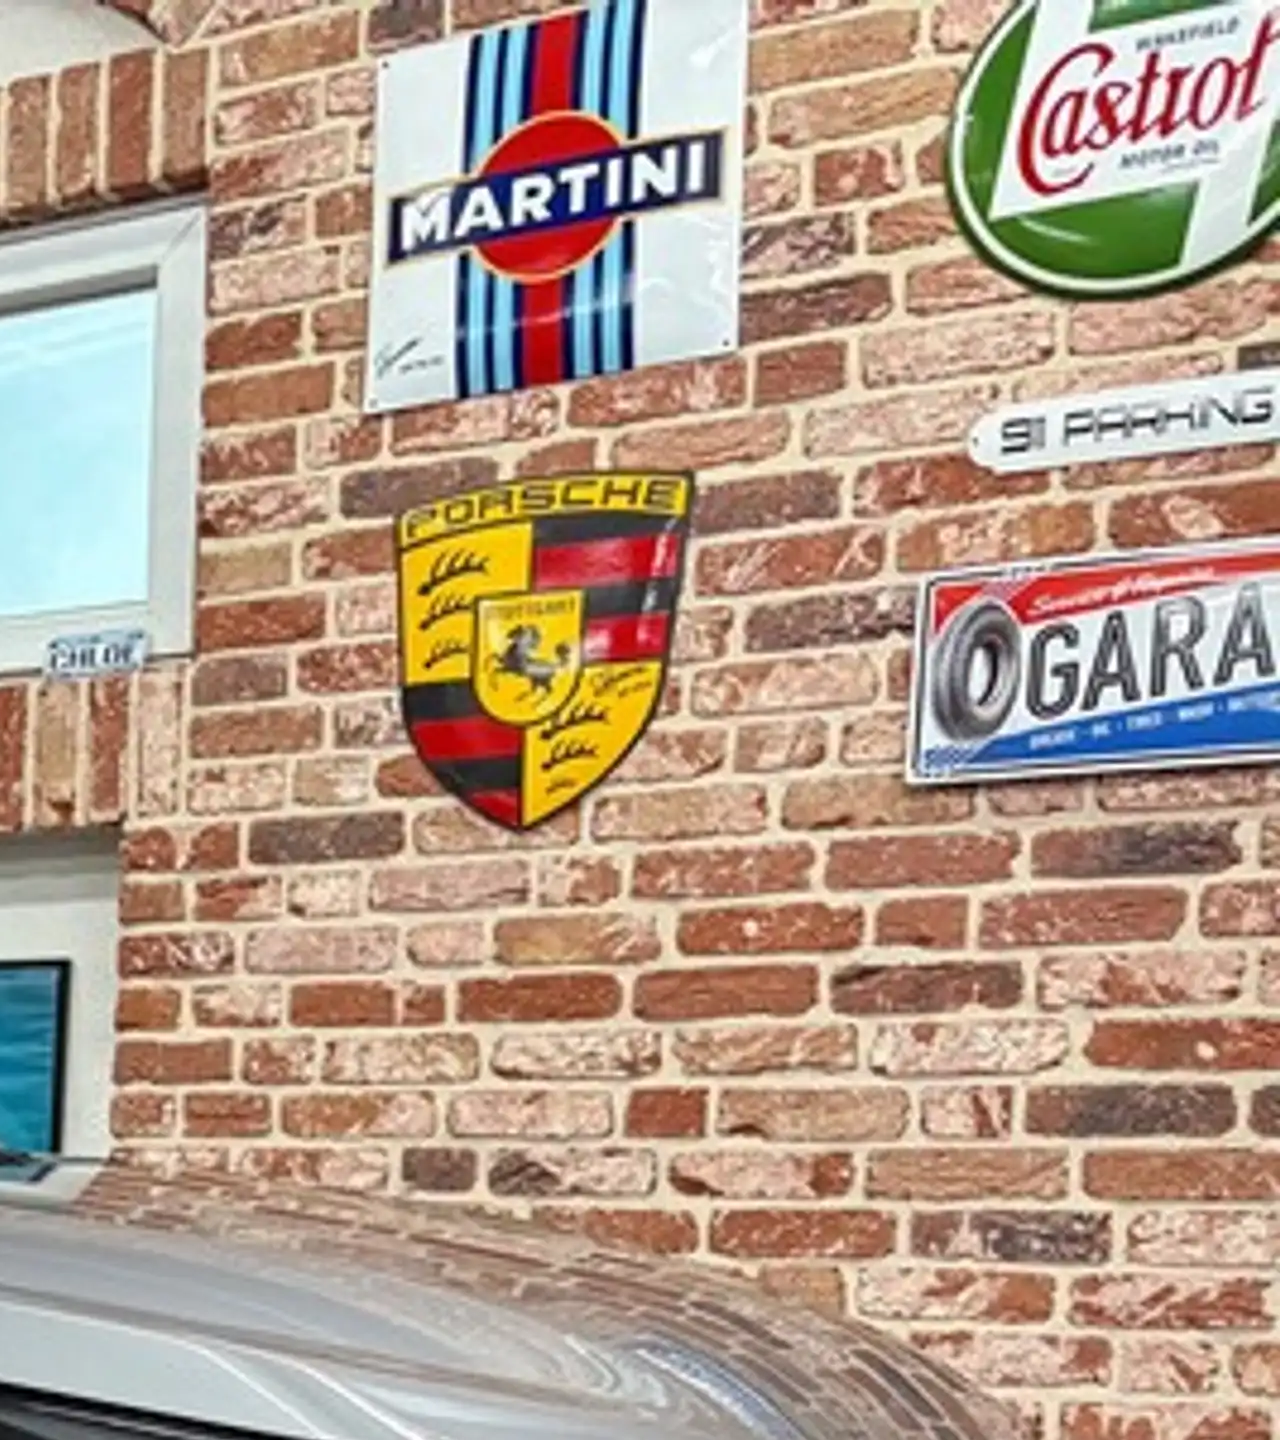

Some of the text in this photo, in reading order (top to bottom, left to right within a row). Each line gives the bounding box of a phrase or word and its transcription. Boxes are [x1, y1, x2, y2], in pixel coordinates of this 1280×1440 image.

[1017, 8, 1280, 196] Castrol
[401, 141, 706, 252] MARTINI
[1062, 384, 1276, 447] PARKING
[405, 479, 685, 540] PORSCHE
